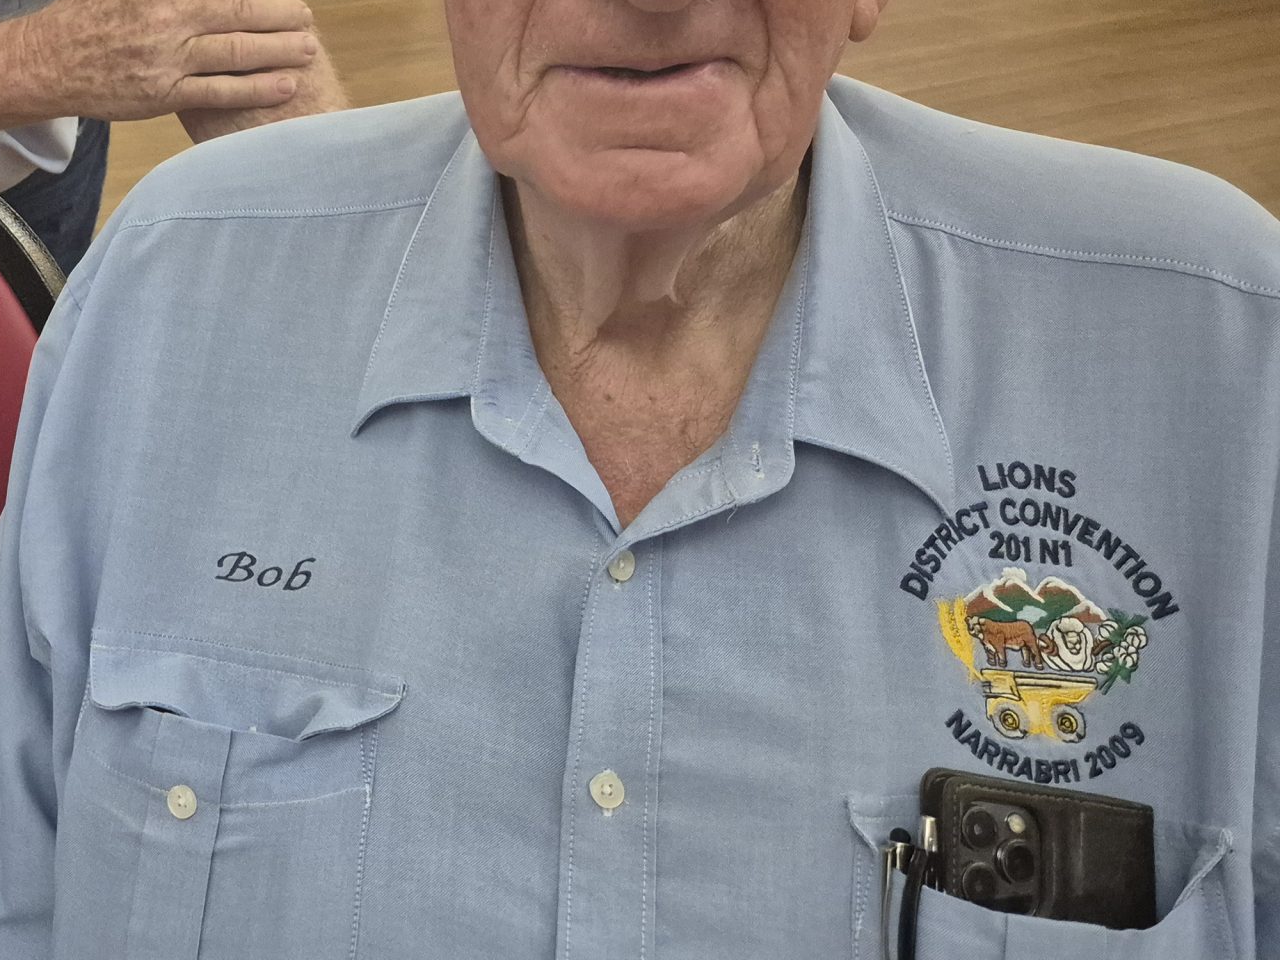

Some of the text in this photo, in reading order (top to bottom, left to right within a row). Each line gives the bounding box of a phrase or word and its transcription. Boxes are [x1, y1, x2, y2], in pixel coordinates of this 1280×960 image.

[977, 461, 1077, 498] LIONS
[899, 497, 1180, 620] DISTRICT CONVENTION
[988, 530, 1073, 567] 201 N1
[215, 551, 317, 591] Bob
[944, 708, 1146, 784] NARRABRI 2009
